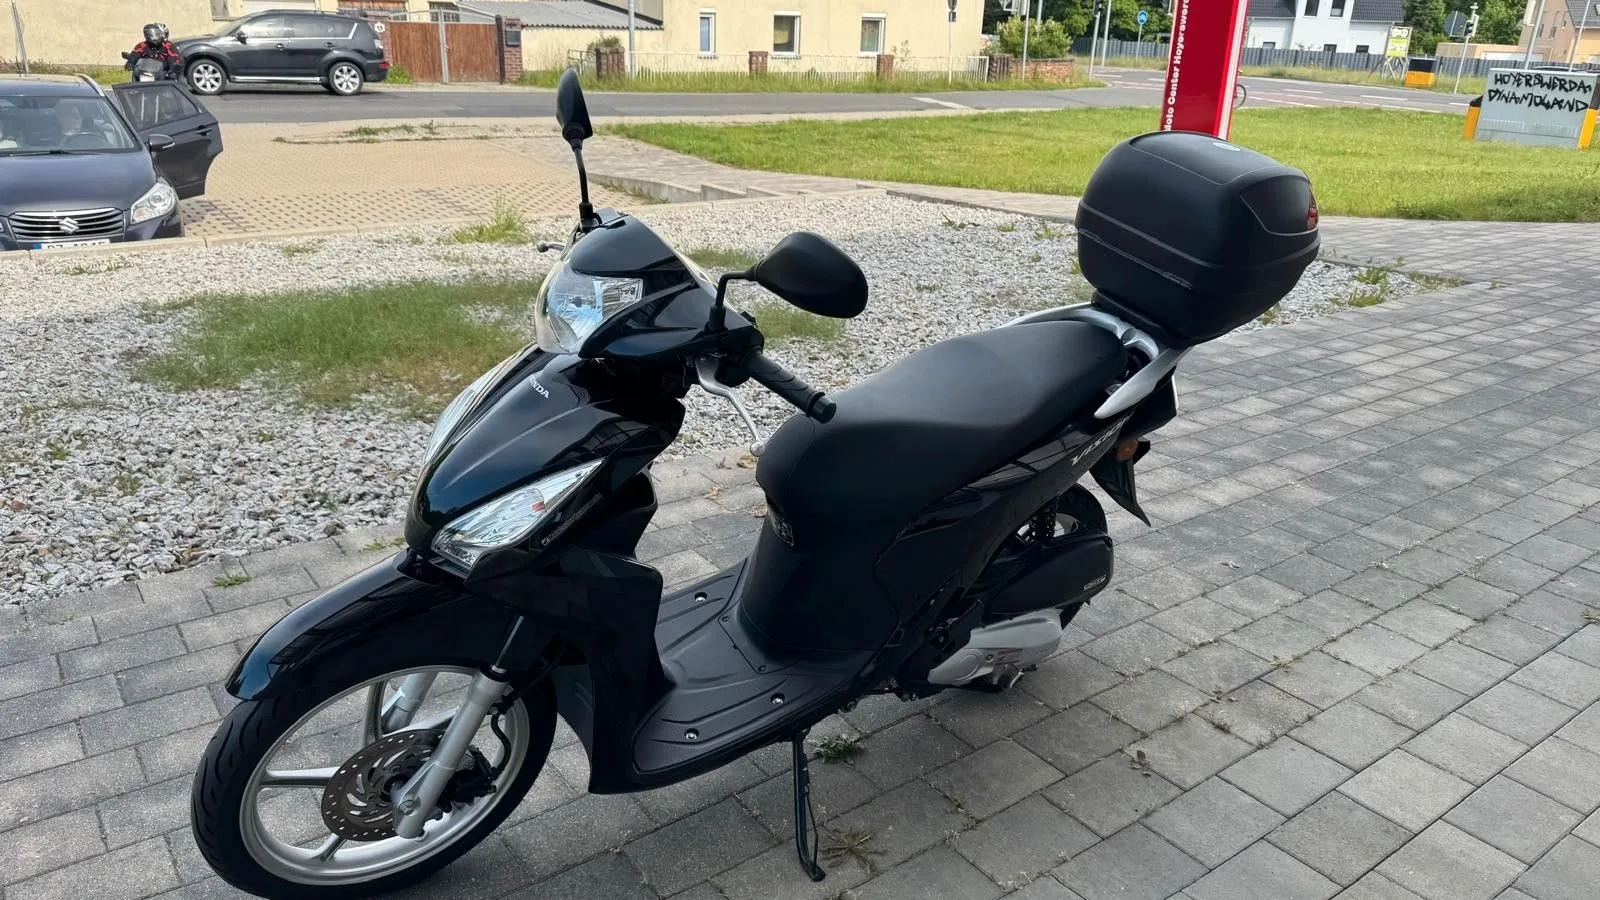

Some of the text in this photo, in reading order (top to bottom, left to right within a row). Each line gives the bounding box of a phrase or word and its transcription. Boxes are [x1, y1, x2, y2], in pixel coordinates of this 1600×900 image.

[1168, 66, 1180, 105] Center
[1494, 72, 1592, 94] HOYERSWERDA
[1488, 88, 1589, 112] DYNAMOLAND
